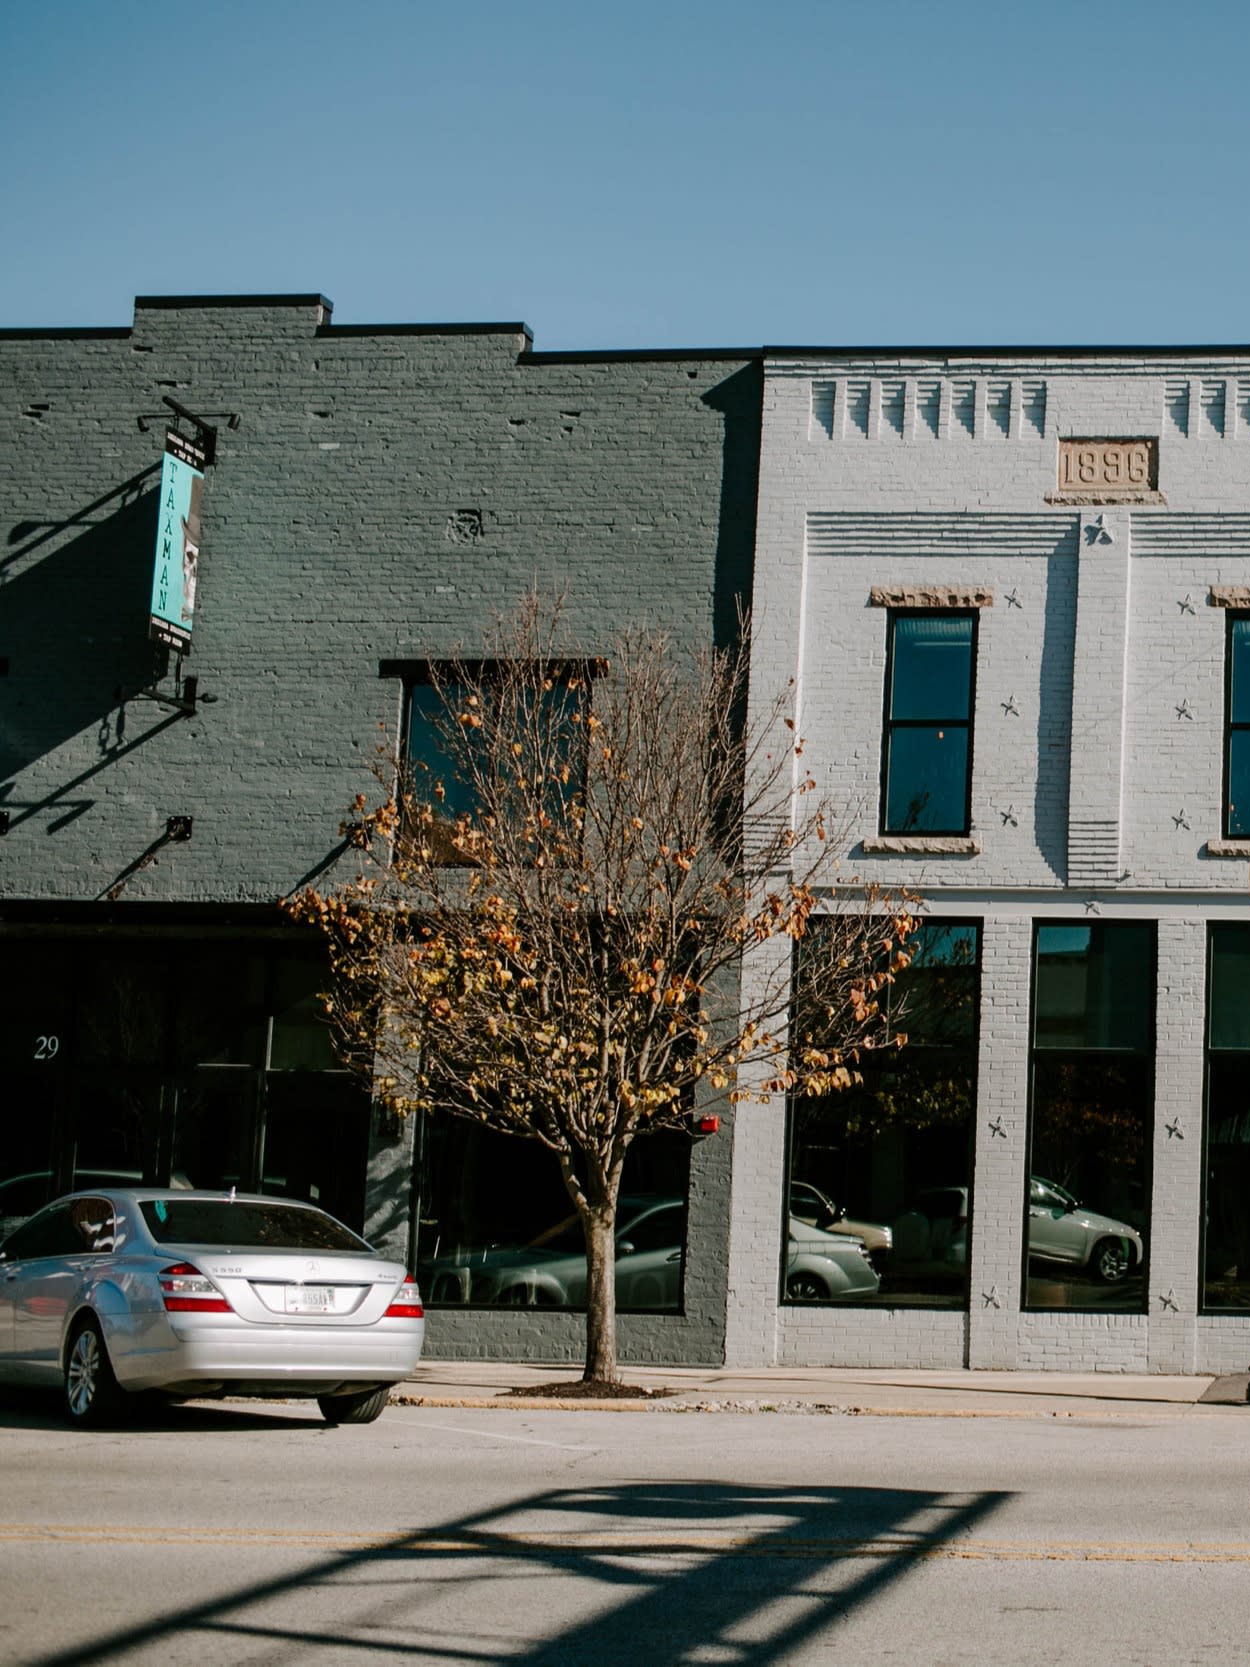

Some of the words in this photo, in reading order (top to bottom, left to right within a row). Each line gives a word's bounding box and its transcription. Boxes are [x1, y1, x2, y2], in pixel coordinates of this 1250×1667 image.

[1063, 446, 1148, 483] 1896
[158, 461, 178, 611] TAXMAN
[34, 1036, 59, 1059] 29
